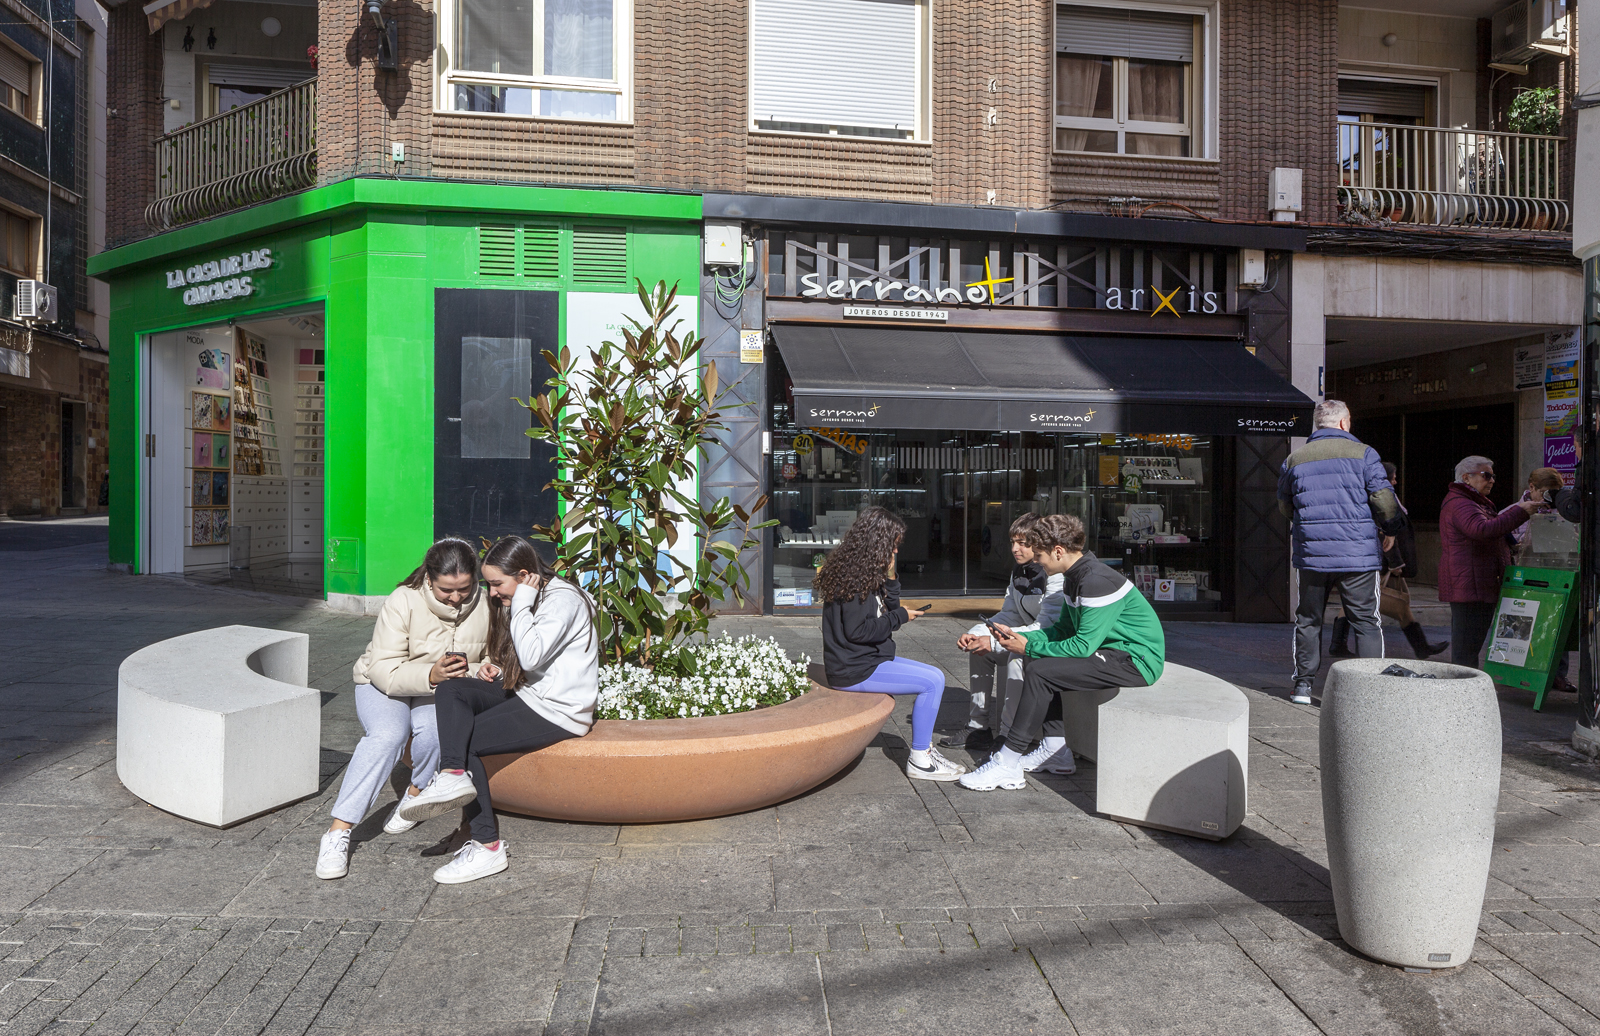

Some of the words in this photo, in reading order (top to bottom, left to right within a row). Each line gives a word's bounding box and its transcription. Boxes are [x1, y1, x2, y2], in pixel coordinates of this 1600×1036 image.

[166, 270, 187, 289] LA
[186, 261, 221, 284] CASA
[220, 255, 241, 277] DE
[241, 248, 271, 271] LAS
[183, 276, 252, 305] CARCASAS
[1105, 284, 1218, 319] arxis
[925, 311, 945, 319] 1943
[187, 335, 204, 345] MODA
[810, 408, 875, 417] serrano
[1030, 413, 1091, 422] serrano
[1237, 418, 1294, 427] serrano
[1548, 443, 1576, 463] Julio
[1139, 469, 1170, 477] TOUS
